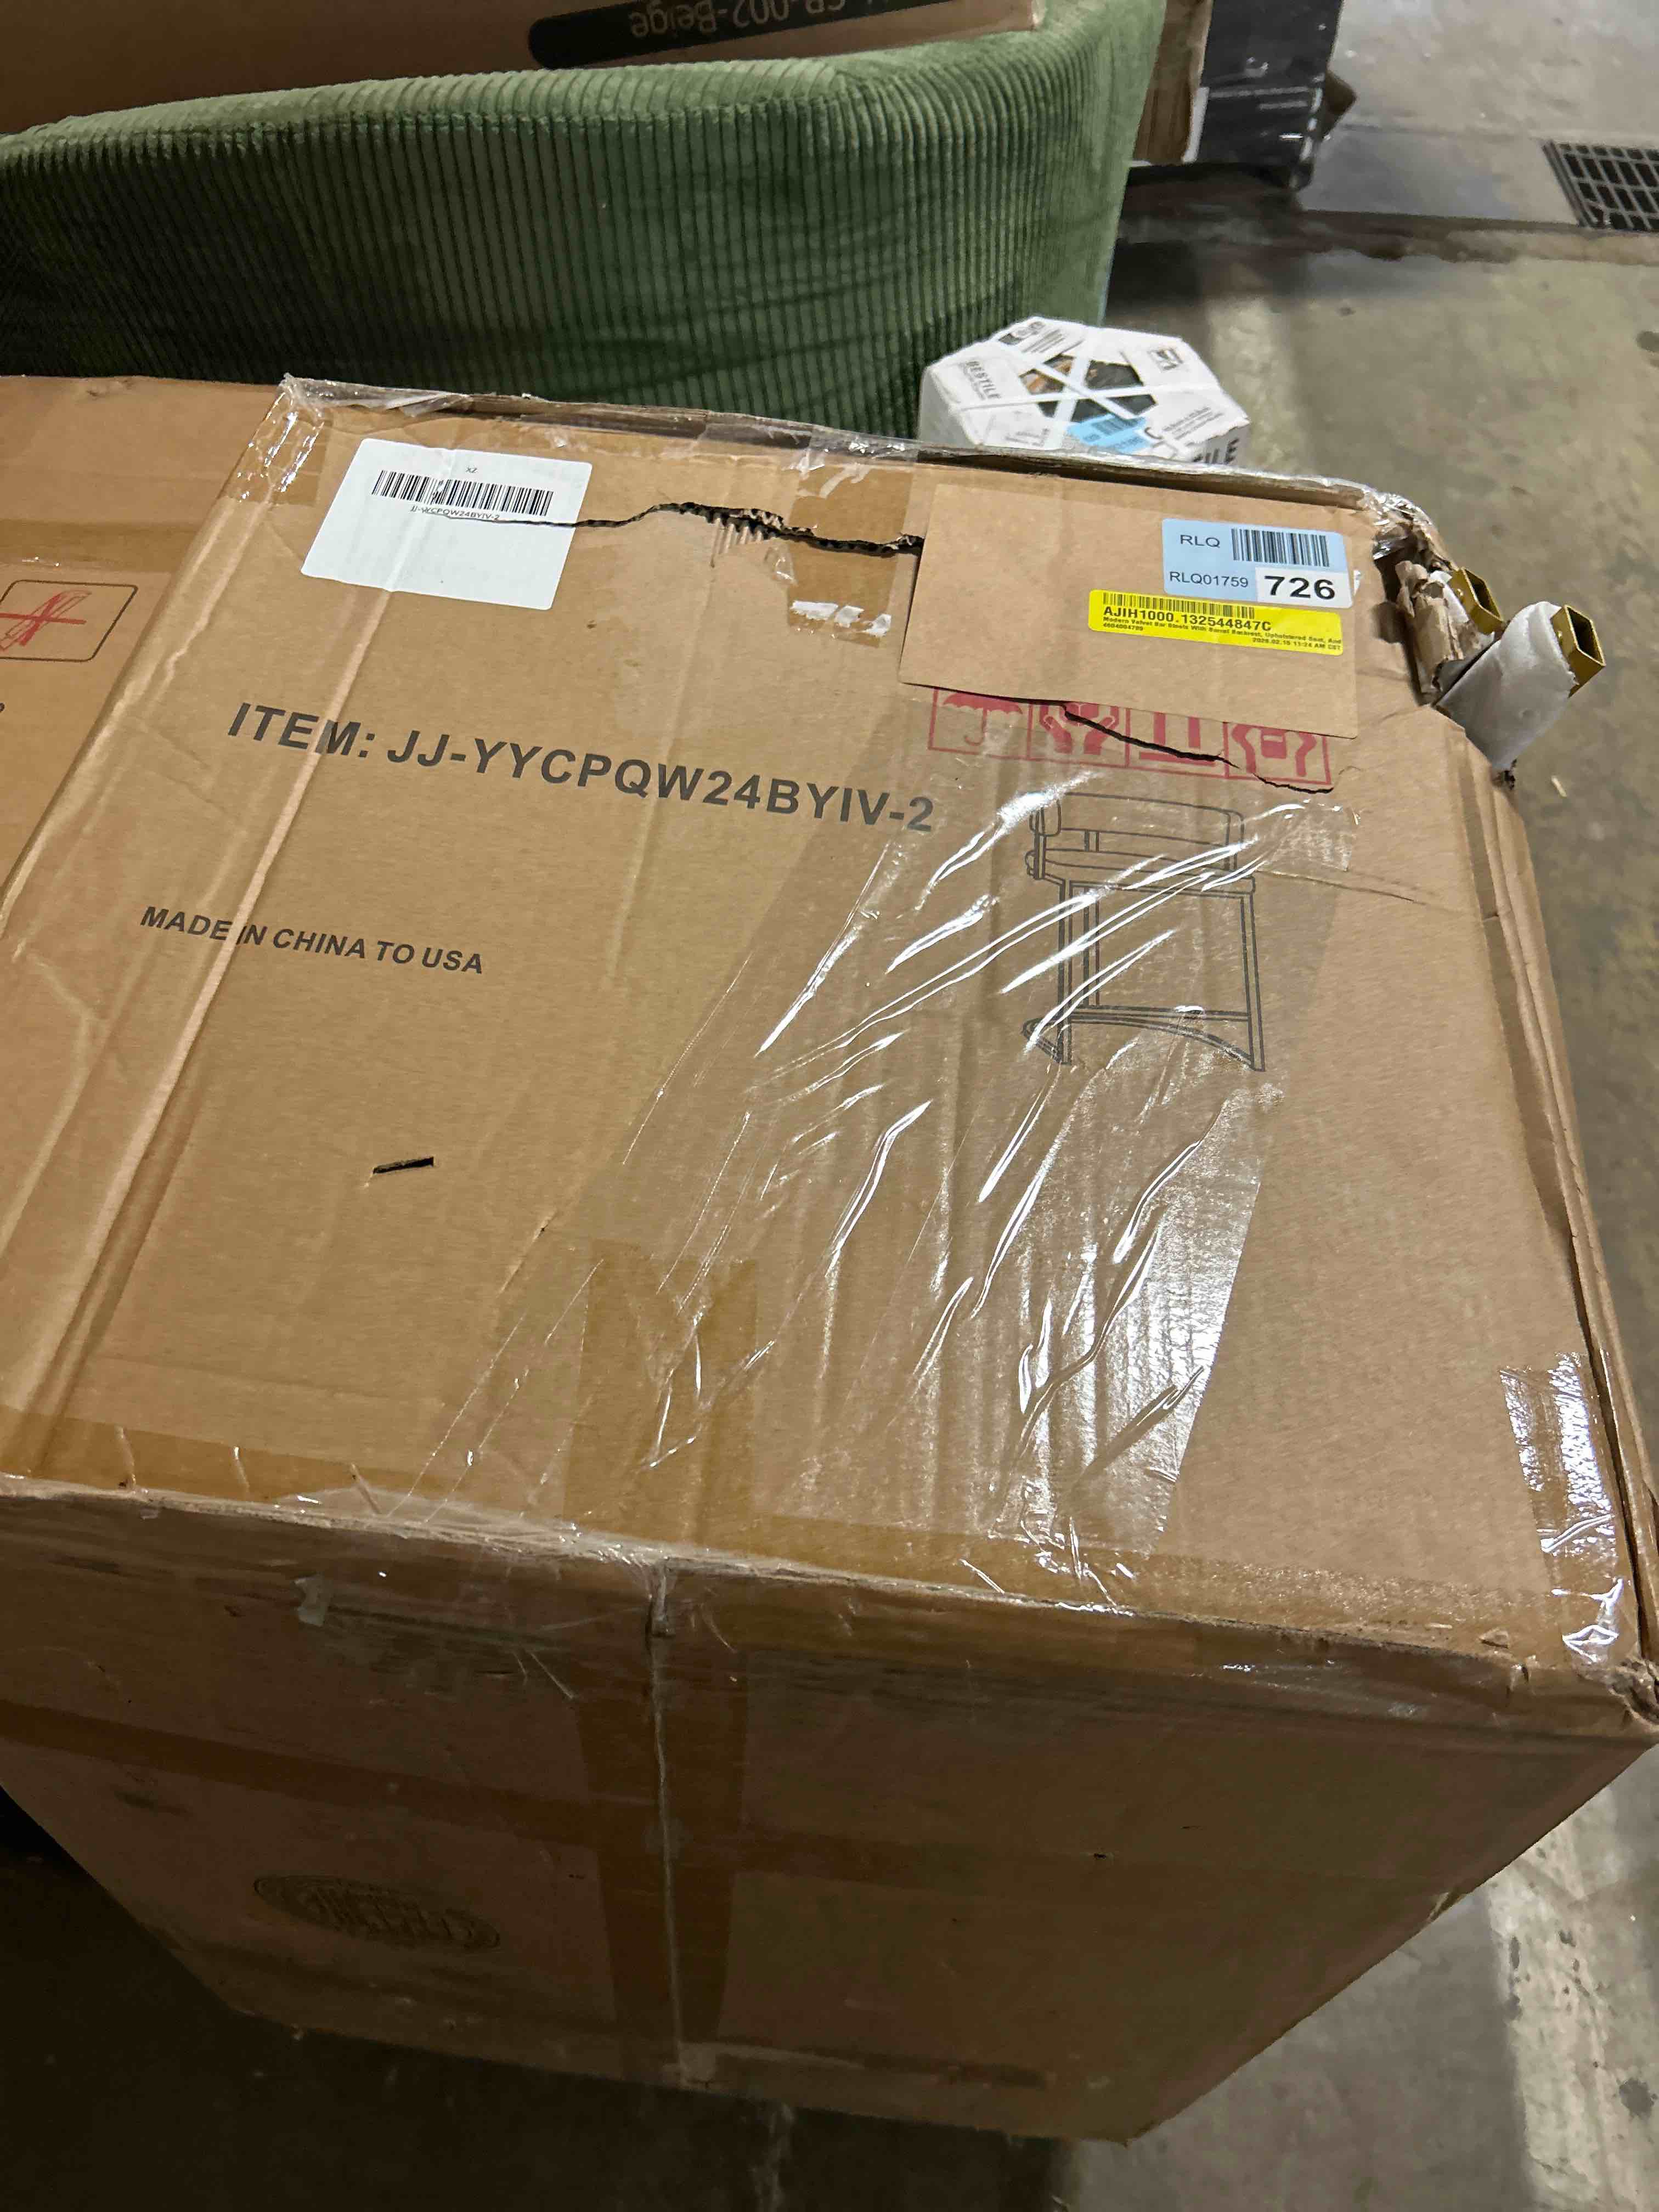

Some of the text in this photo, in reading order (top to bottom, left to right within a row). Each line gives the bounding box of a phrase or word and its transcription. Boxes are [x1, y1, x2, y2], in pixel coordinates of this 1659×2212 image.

[1180, 534, 1221, 548] RLQ
[1169, 571, 1249, 588] RLQ01759
[1263, 575, 1336, 600] 726
[1103, 606, 1272, 631] AJIH1000.132544847C
[228, 701, 934, 832] ITEM: JJ-YYCPQW24BYIV-2
[140, 906, 483, 975] MADE IN CHINA TO USA
